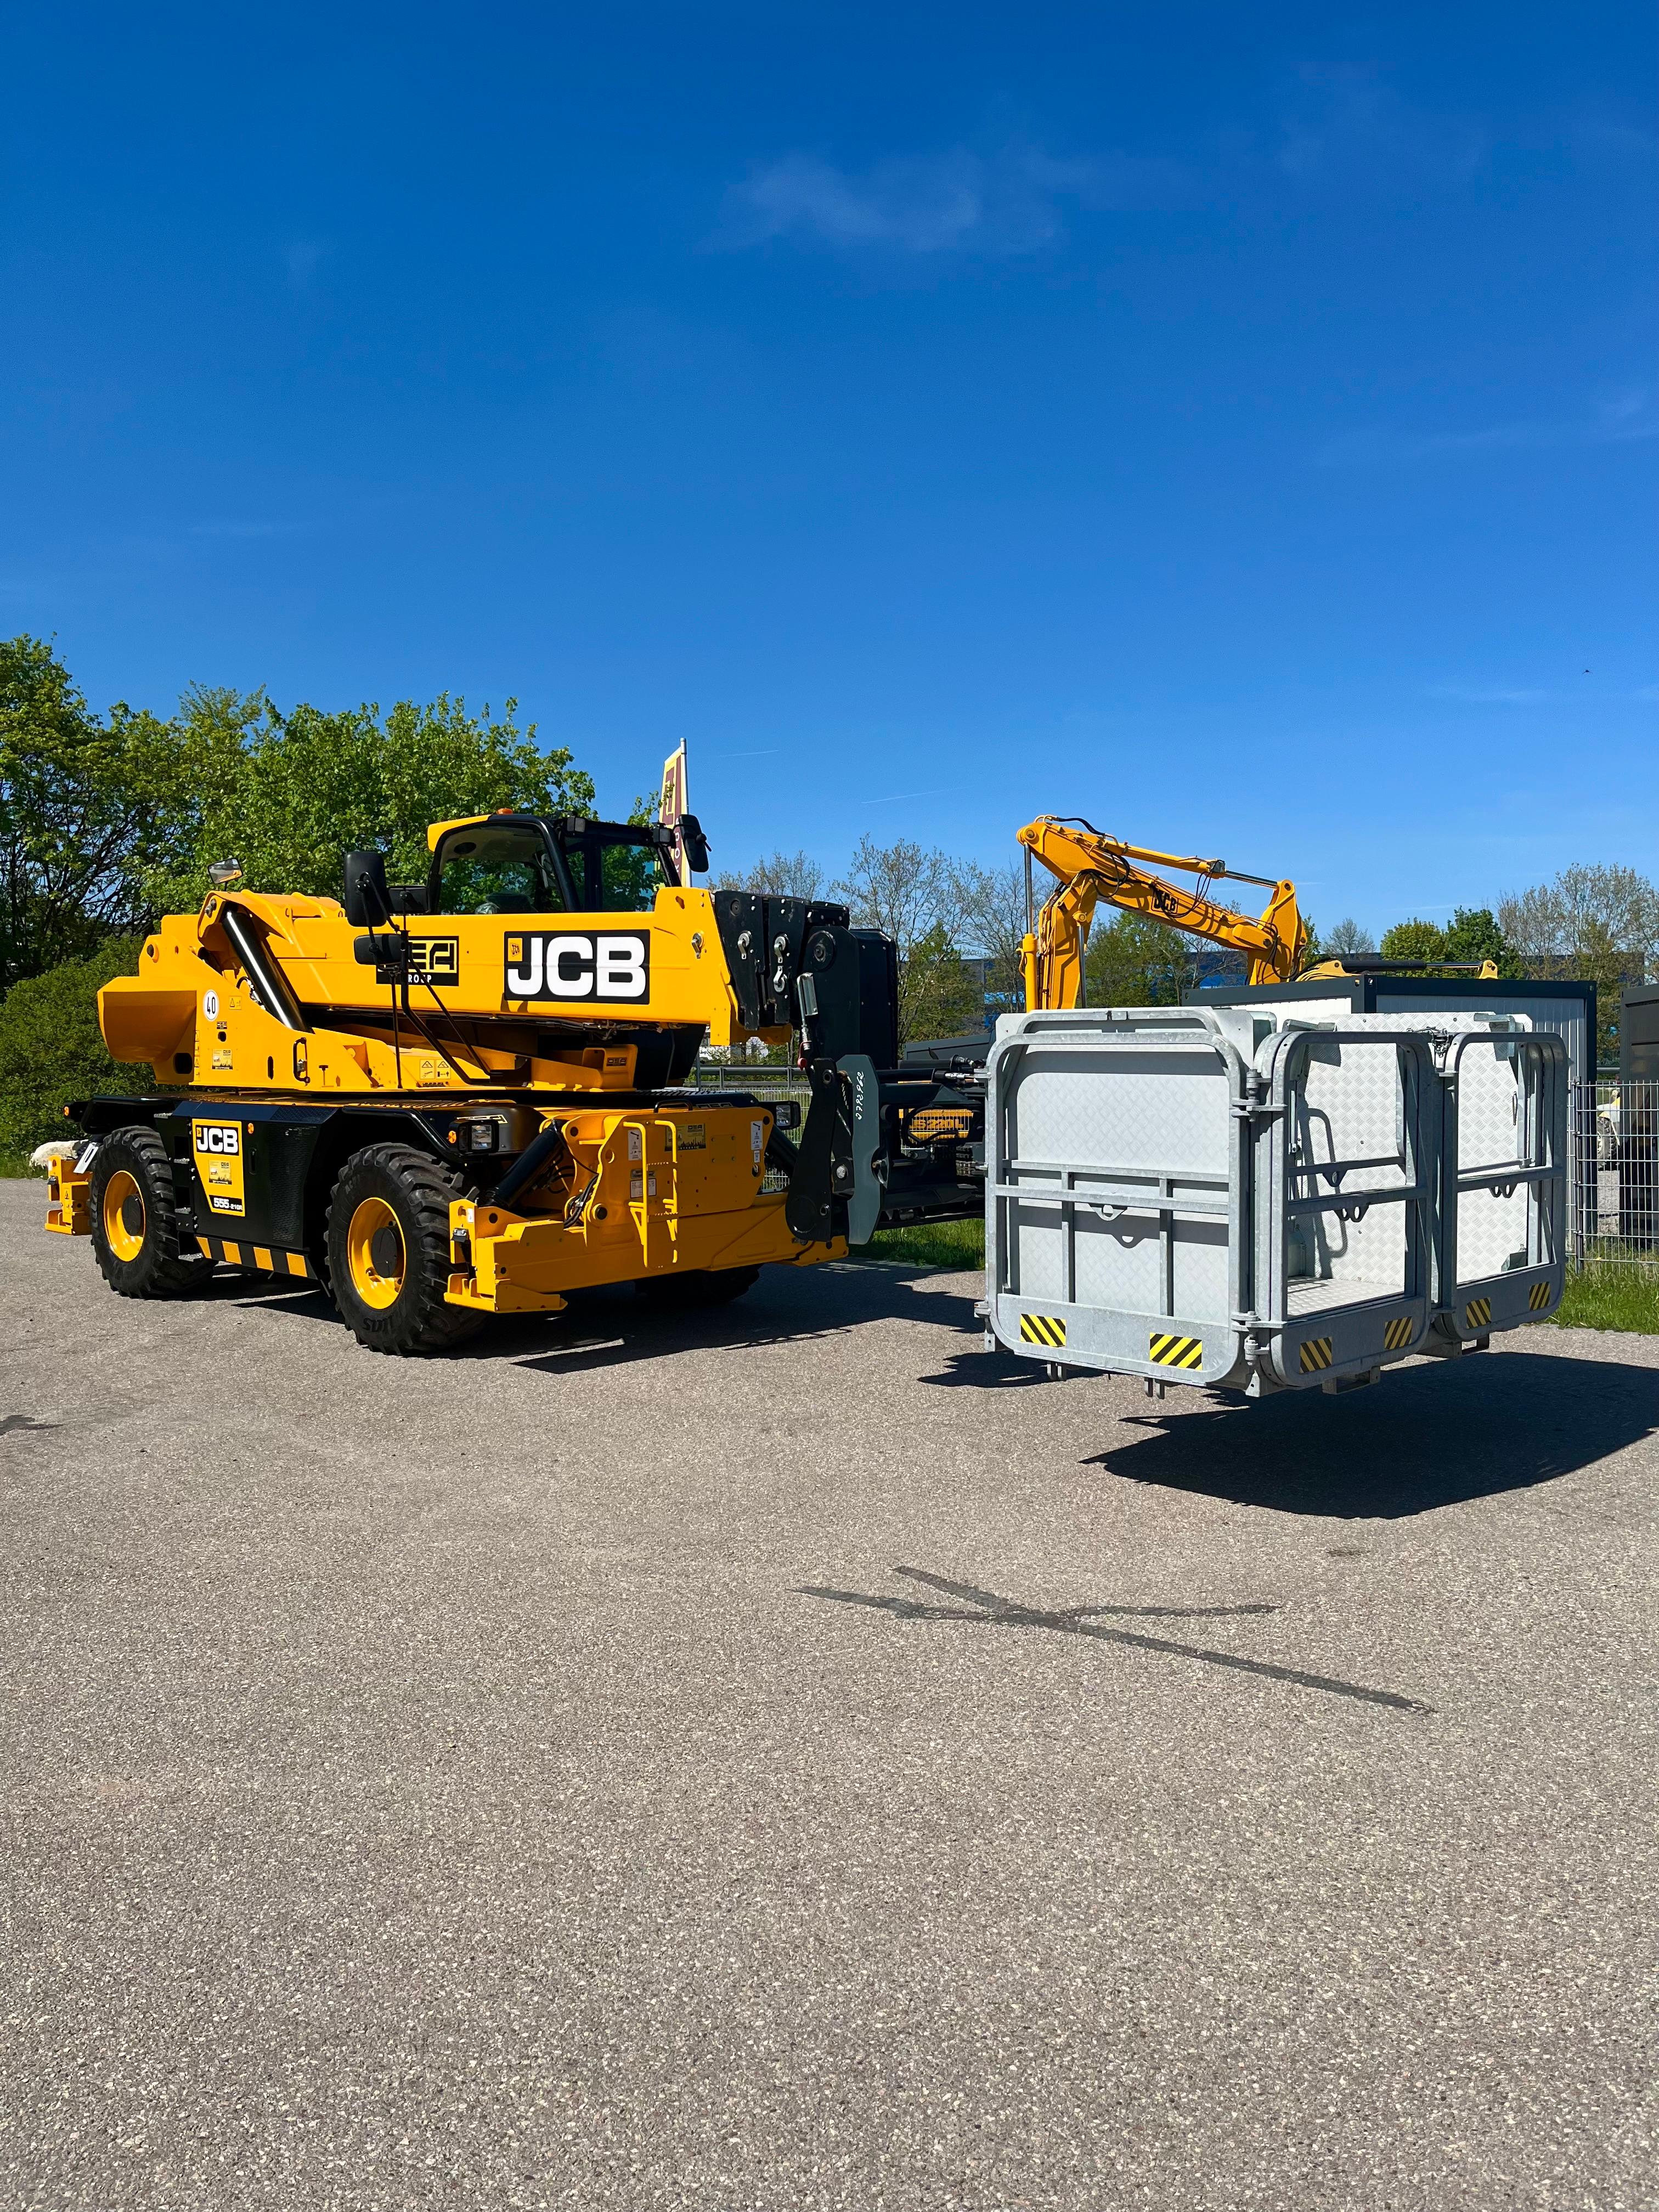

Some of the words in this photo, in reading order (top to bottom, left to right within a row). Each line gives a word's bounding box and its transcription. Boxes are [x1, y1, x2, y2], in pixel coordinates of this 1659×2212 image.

[511, 944, 520, 955] JCB
[507, 936, 646, 997] JCB
[207, 997, 216, 1014] 40
[196, 1127, 238, 1153] JCB
